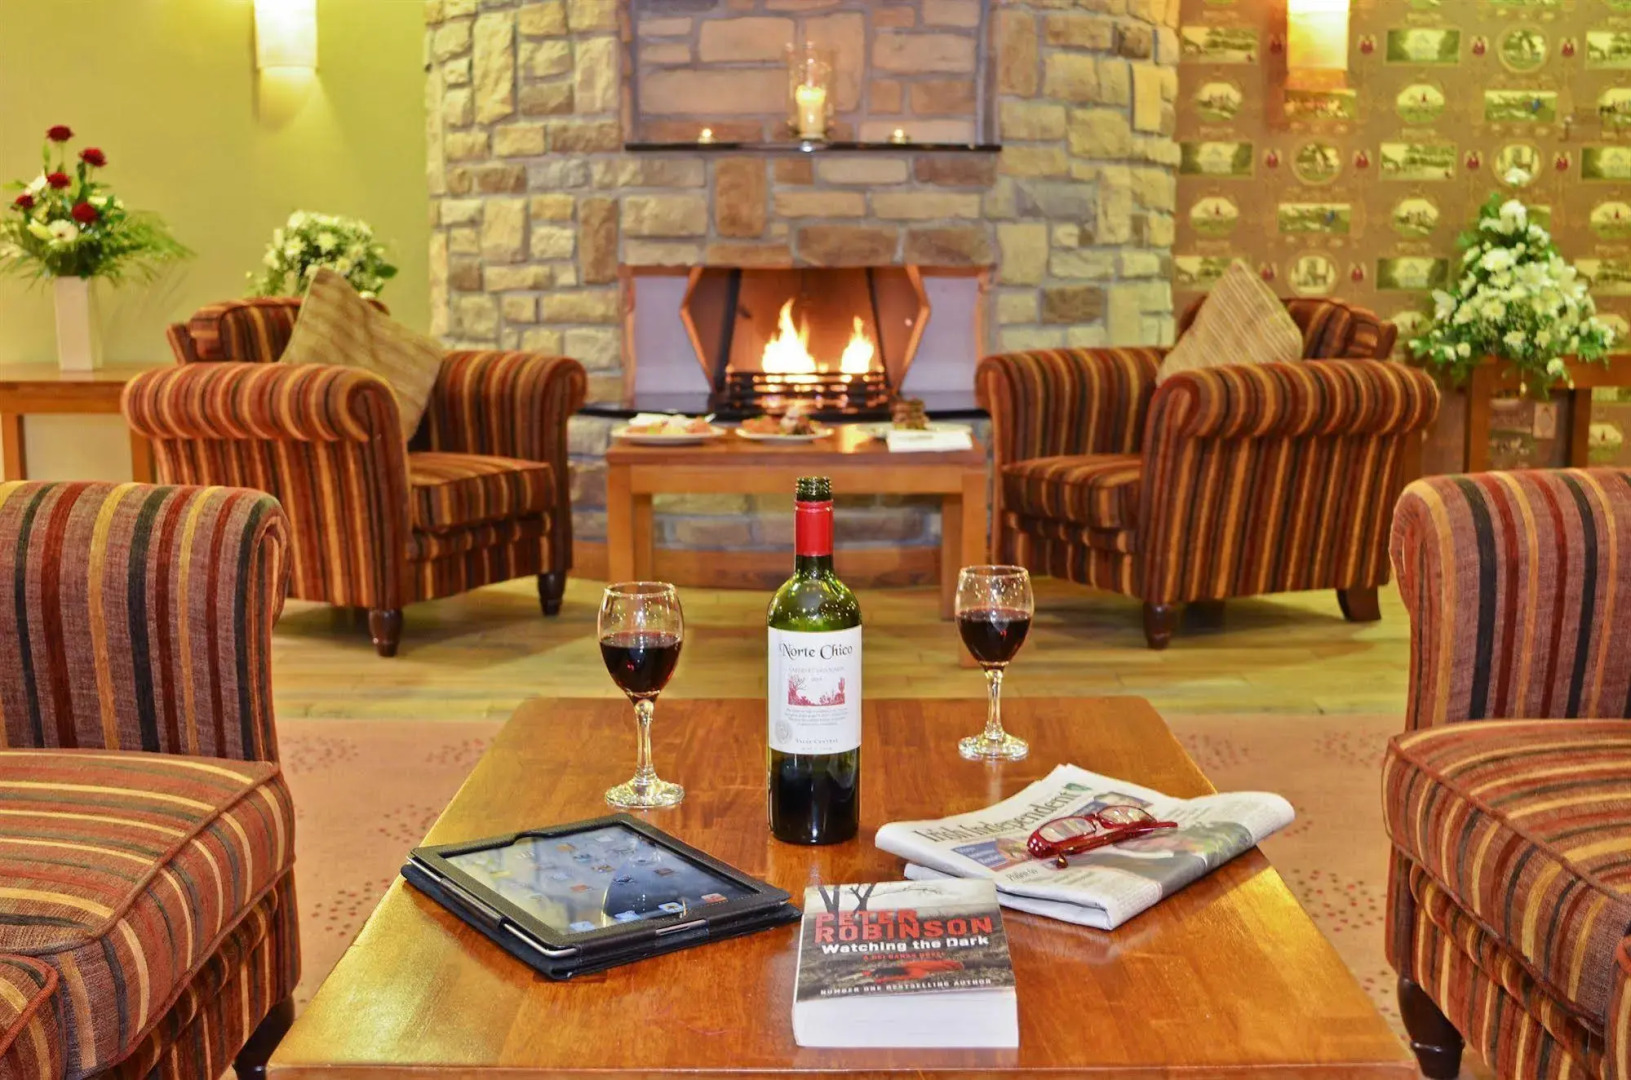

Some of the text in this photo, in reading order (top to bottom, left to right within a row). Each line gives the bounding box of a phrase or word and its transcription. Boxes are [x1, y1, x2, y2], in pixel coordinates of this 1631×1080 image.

[779, 642, 853, 660] Norte Chico
[913, 791, 1079, 843] Irish Independent
[814, 909, 917, 927] PETER
[814, 916, 992, 943] ROBINSON
[821, 936, 989, 955] Watching the Dark
[886, 982, 950, 991] BESTSELLING
[954, 979, 991, 987] AUTHOR
